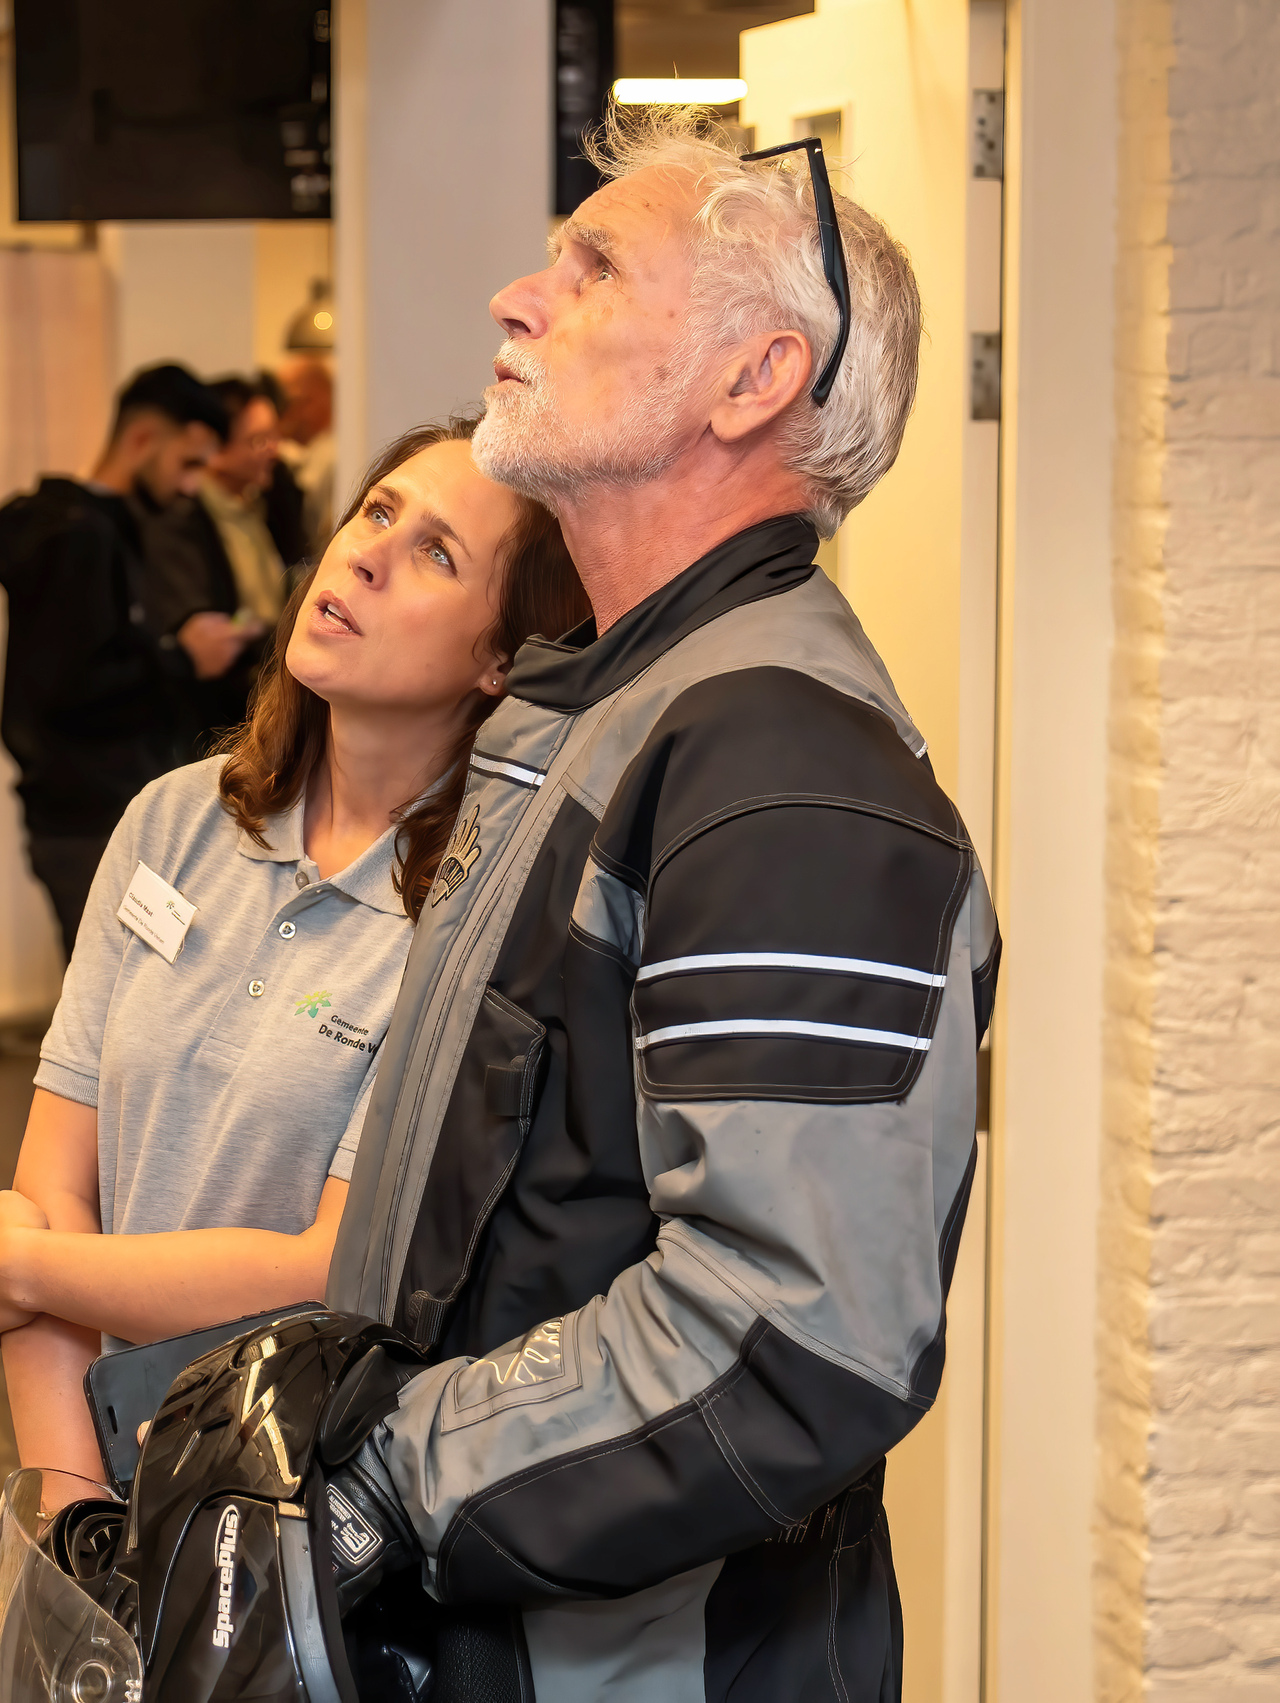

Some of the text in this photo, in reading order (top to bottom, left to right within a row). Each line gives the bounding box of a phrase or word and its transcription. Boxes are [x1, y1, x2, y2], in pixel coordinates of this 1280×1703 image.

[318, 1024, 333, 1038] De
[333, 1031, 366, 1052] Ronde
[330, 1015, 369, 1036] Gemeente
[212, 1513, 239, 1649] Spaceplus
